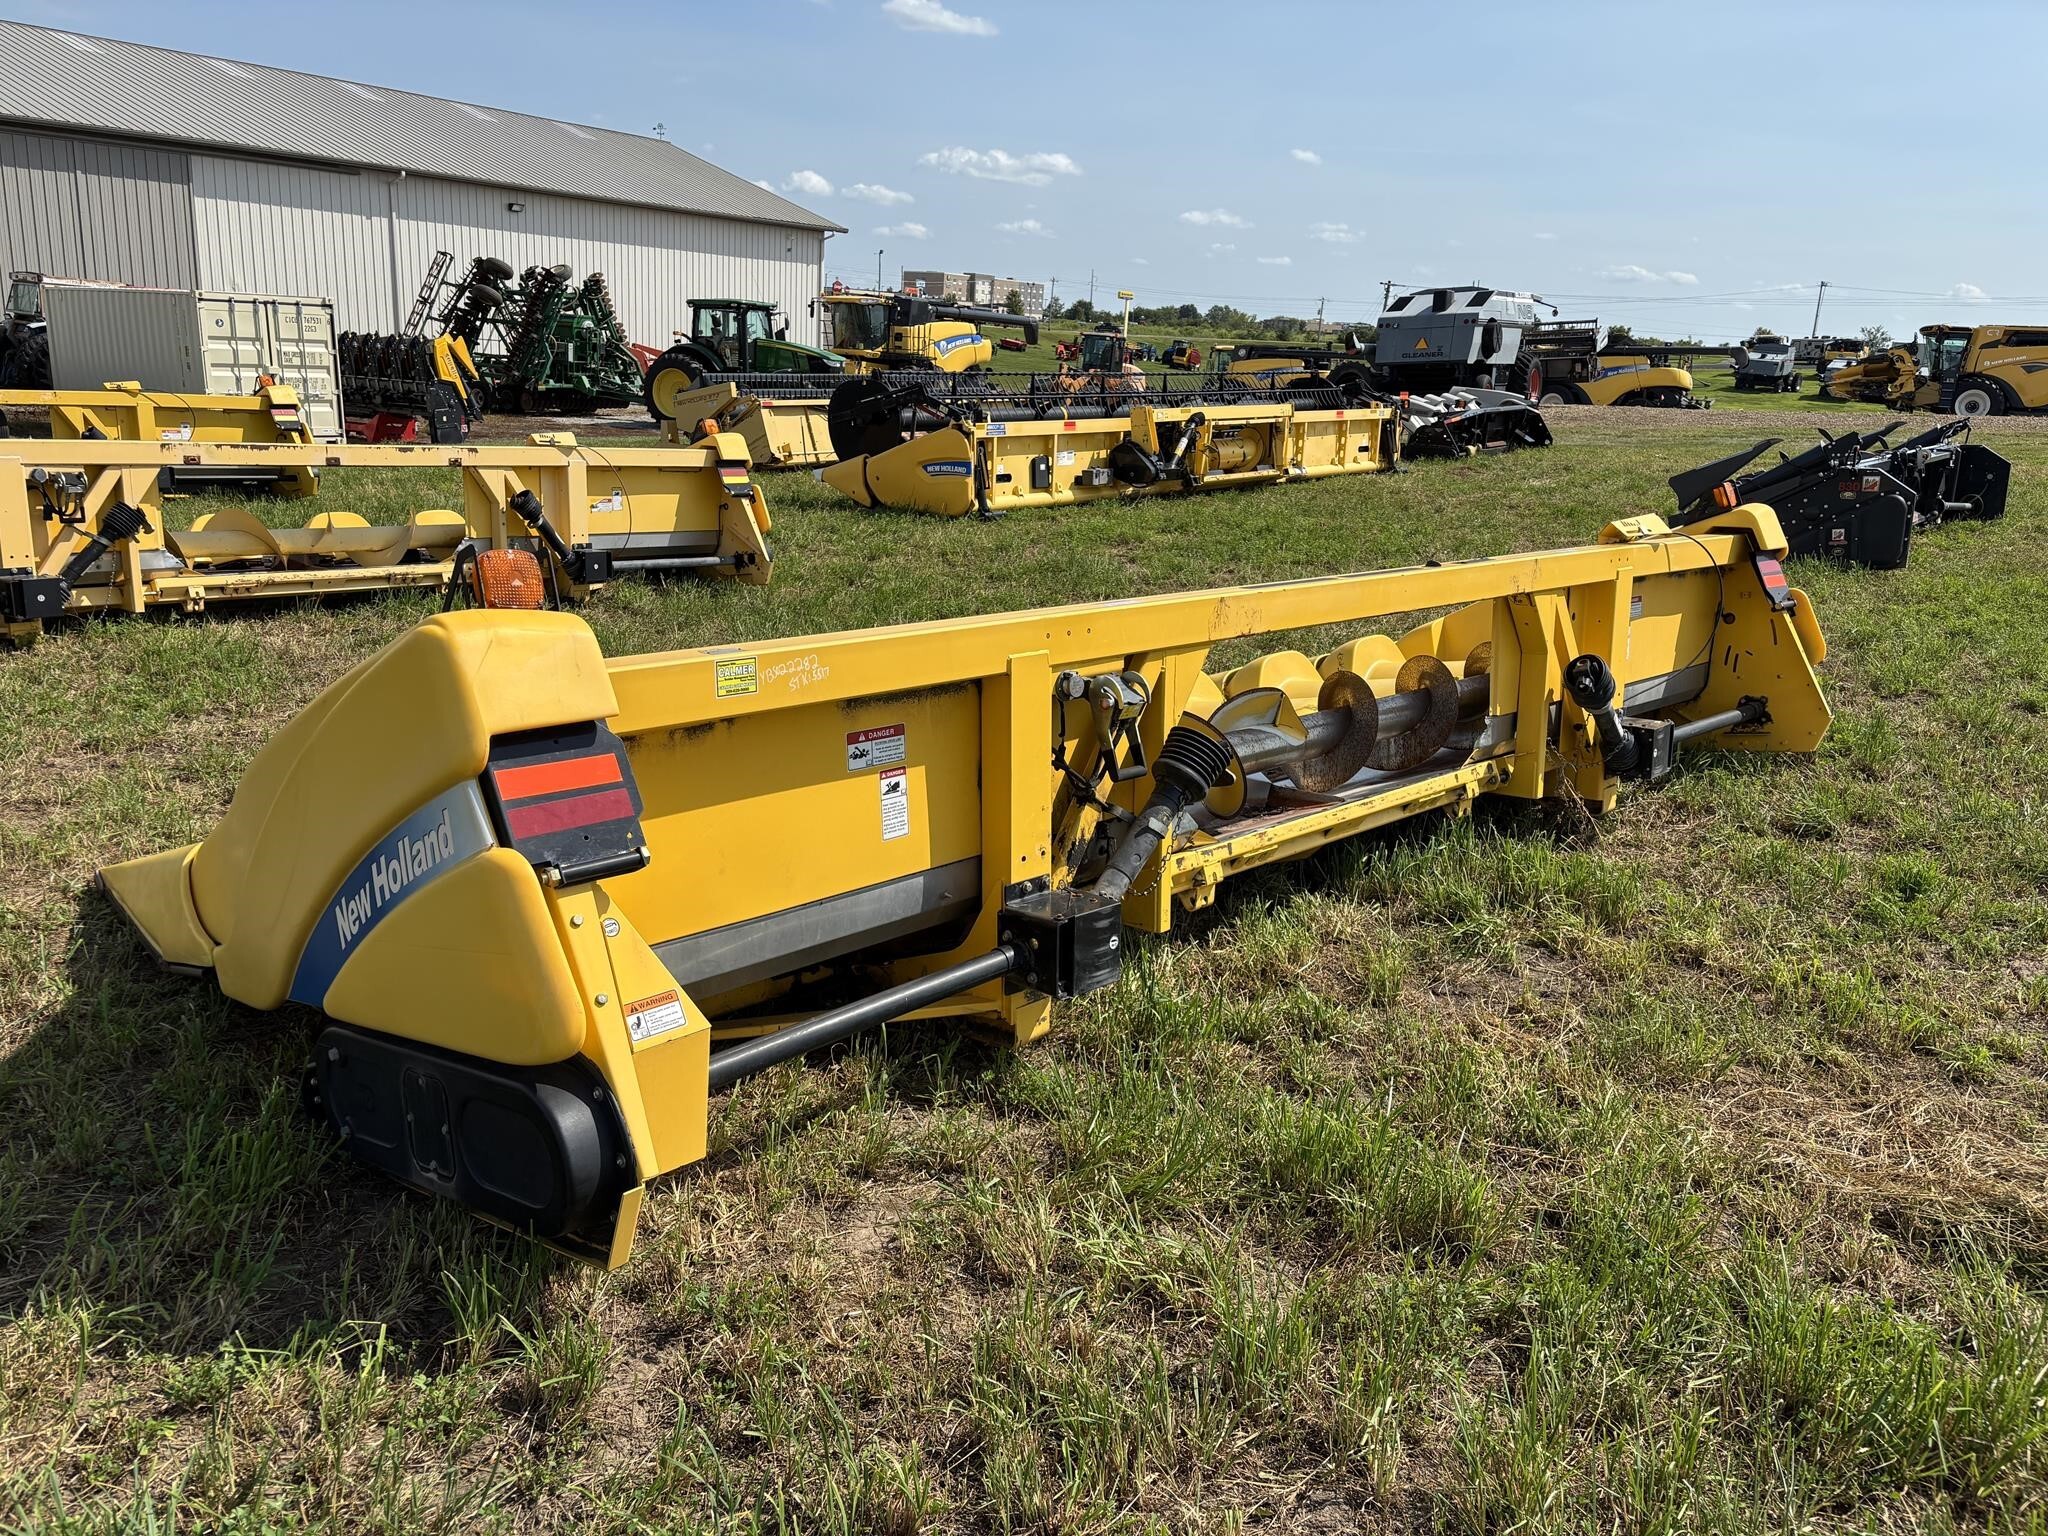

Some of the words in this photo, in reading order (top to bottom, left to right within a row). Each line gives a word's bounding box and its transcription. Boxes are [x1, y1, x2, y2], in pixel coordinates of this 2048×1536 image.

[1401, 351, 1444, 359] GLEANER
[927, 465, 940, 473] NEW
[940, 465, 967, 474] HOLLAND
[718, 663, 755, 679] CALMER
[868, 728, 895, 739] DANGER
[886, 769, 904, 777] DANGER
[335, 881, 372, 950] New
[371, 808, 455, 908] Holland
[637, 993, 674, 1009] WARNING
